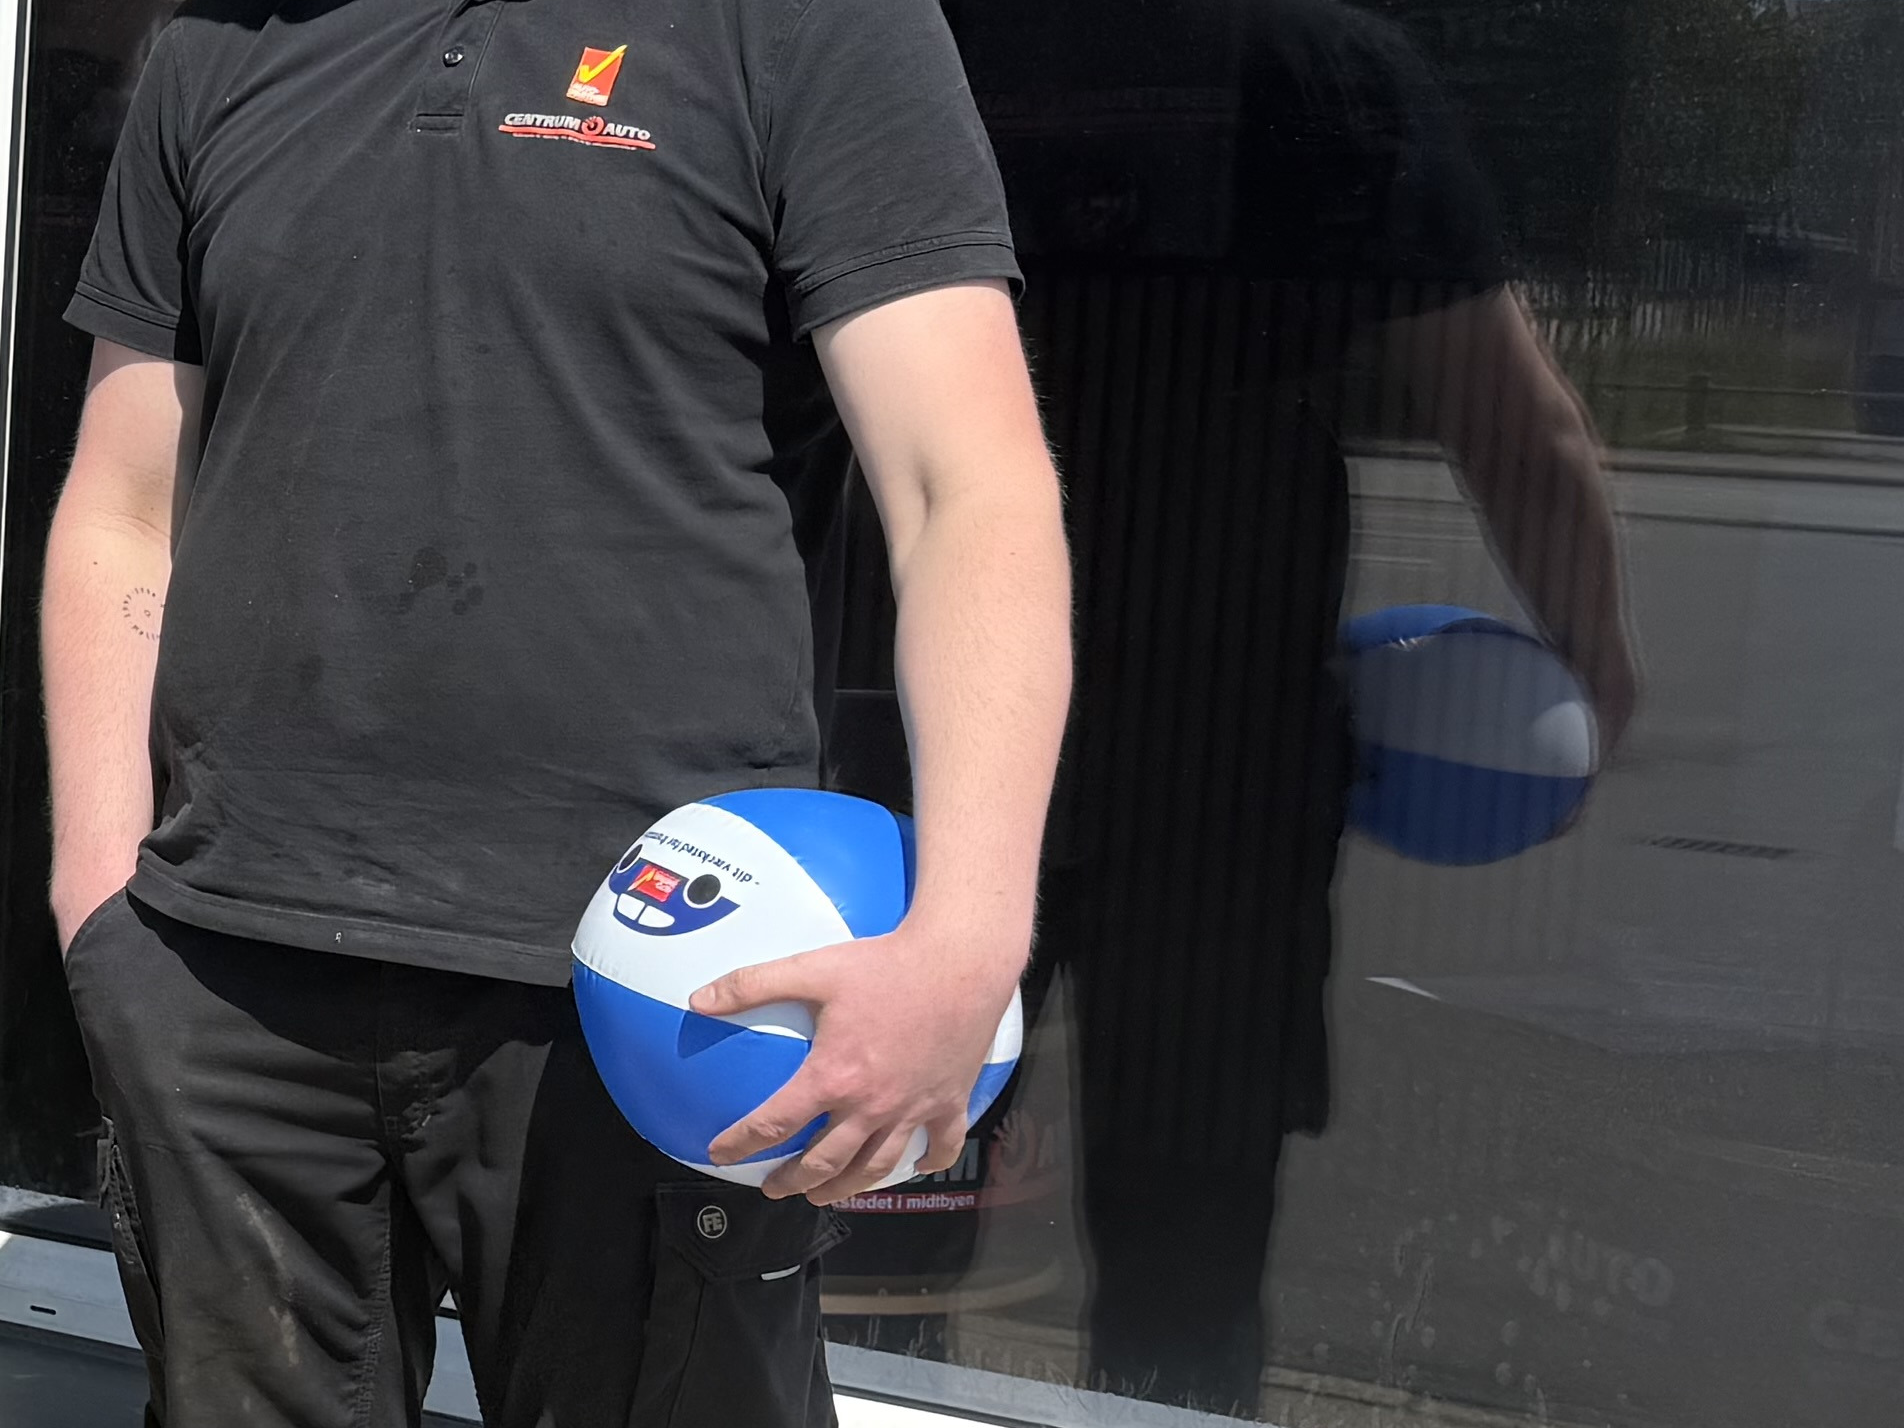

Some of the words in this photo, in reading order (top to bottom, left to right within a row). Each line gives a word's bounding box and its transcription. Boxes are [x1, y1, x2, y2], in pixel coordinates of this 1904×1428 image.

[503, 112, 582, 131] CENTRUM
[603, 122, 651, 140] AUTO
[906, 1193, 976, 1211] midtbyen
